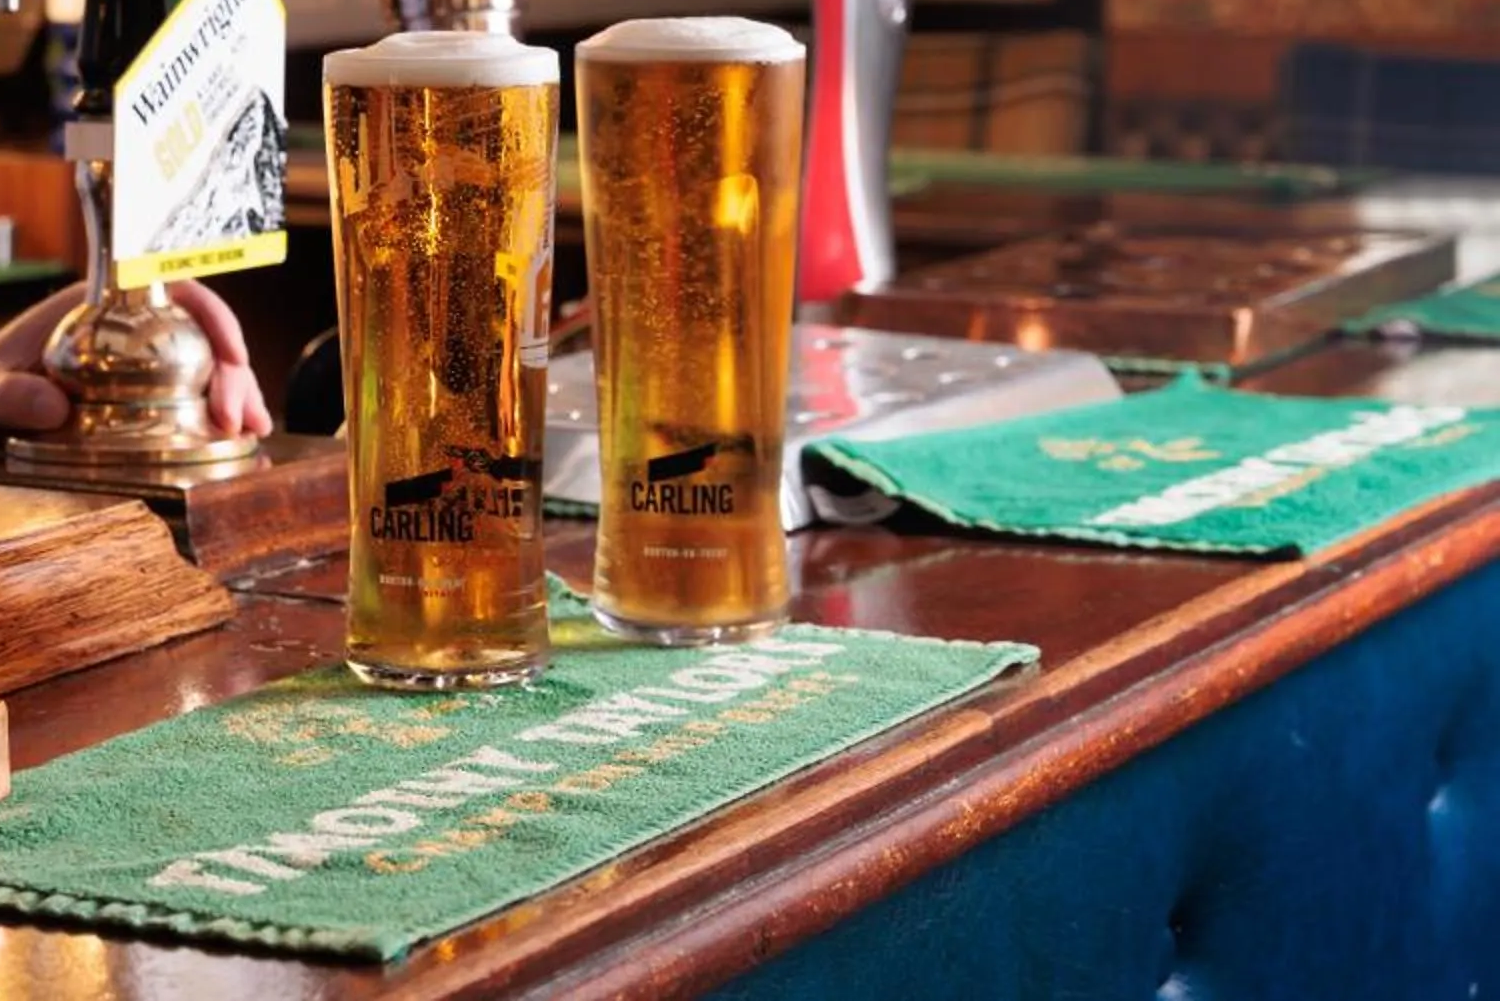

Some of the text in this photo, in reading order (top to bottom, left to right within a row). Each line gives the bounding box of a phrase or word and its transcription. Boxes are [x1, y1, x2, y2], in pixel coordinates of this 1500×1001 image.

[631, 480, 735, 515] CARLING
[370, 506, 474, 542] CARLING
[145, 745, 560, 896] TIMOTHY
